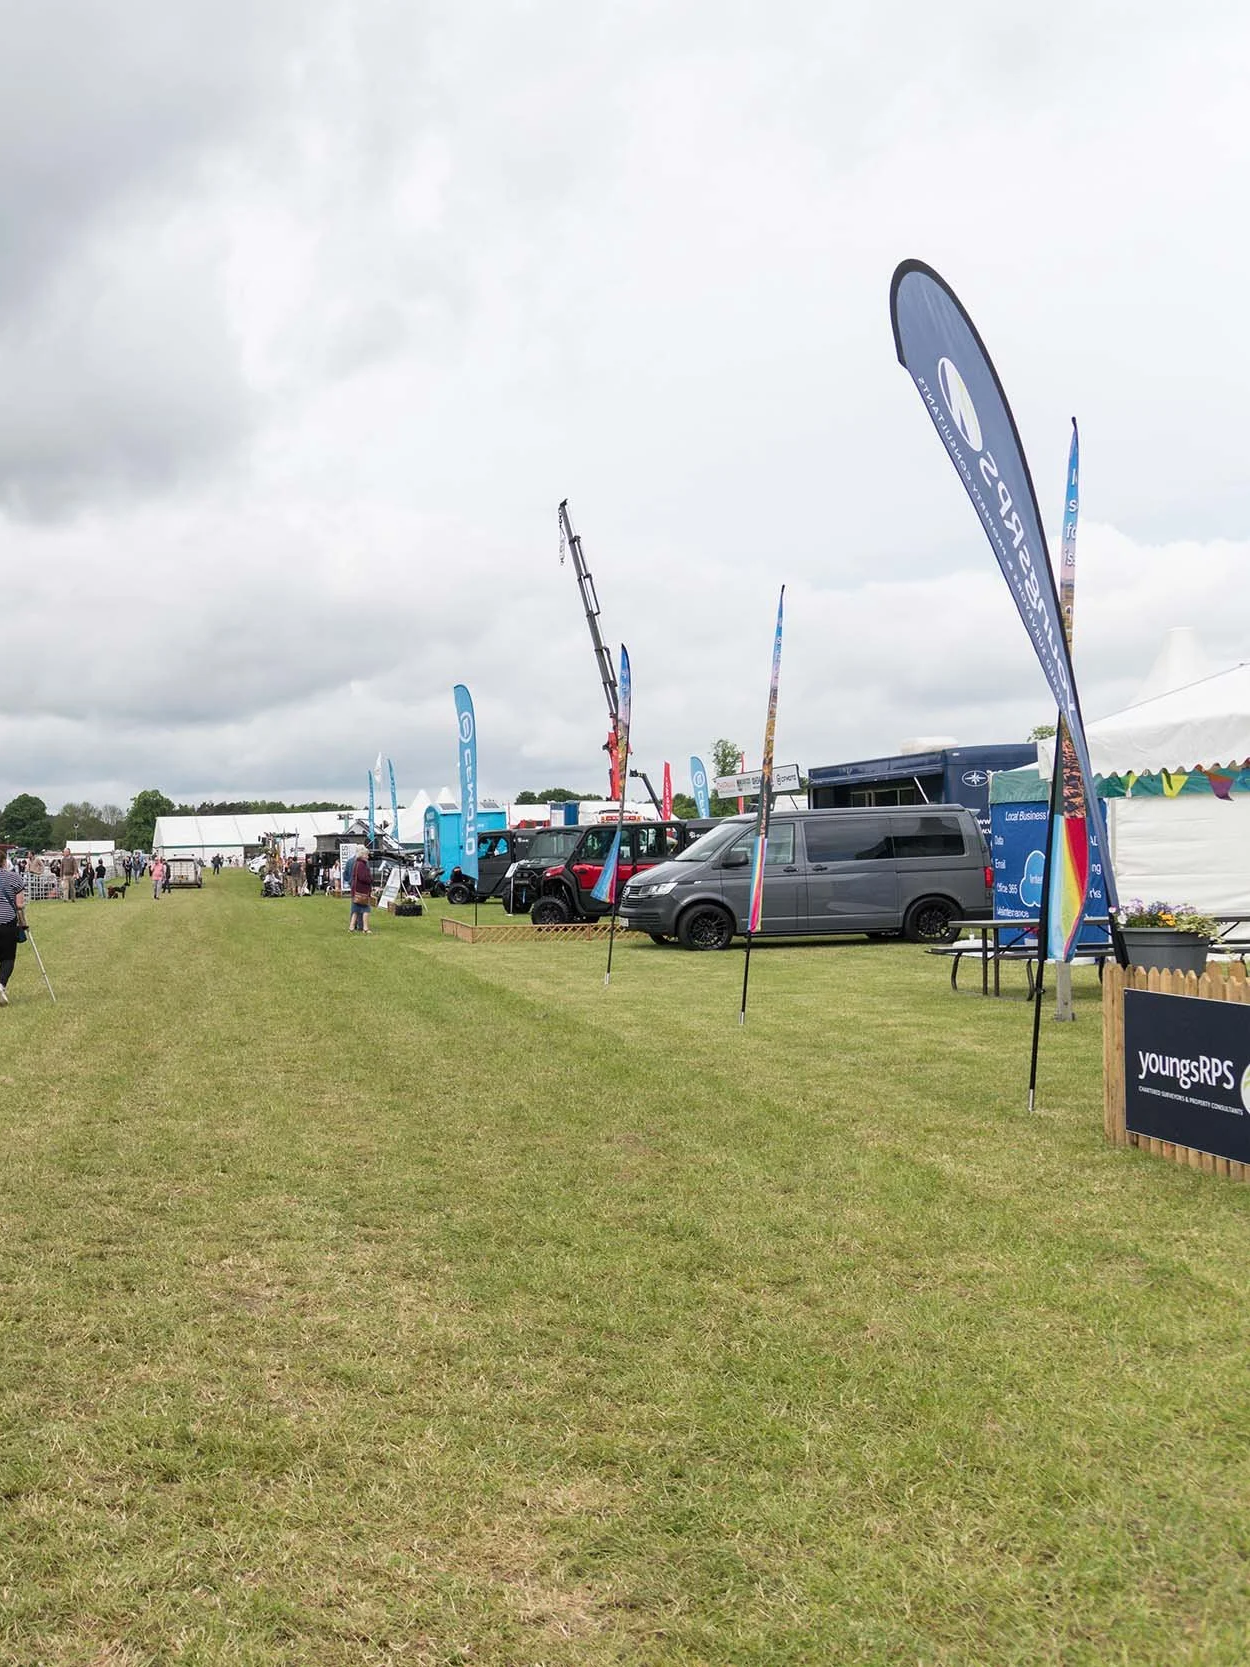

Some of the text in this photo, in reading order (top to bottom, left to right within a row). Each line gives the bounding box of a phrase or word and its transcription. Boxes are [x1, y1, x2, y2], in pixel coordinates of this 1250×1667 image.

[1005, 810, 1047, 821] Local Business
[1138, 1050, 1235, 1090] youngsRPS
